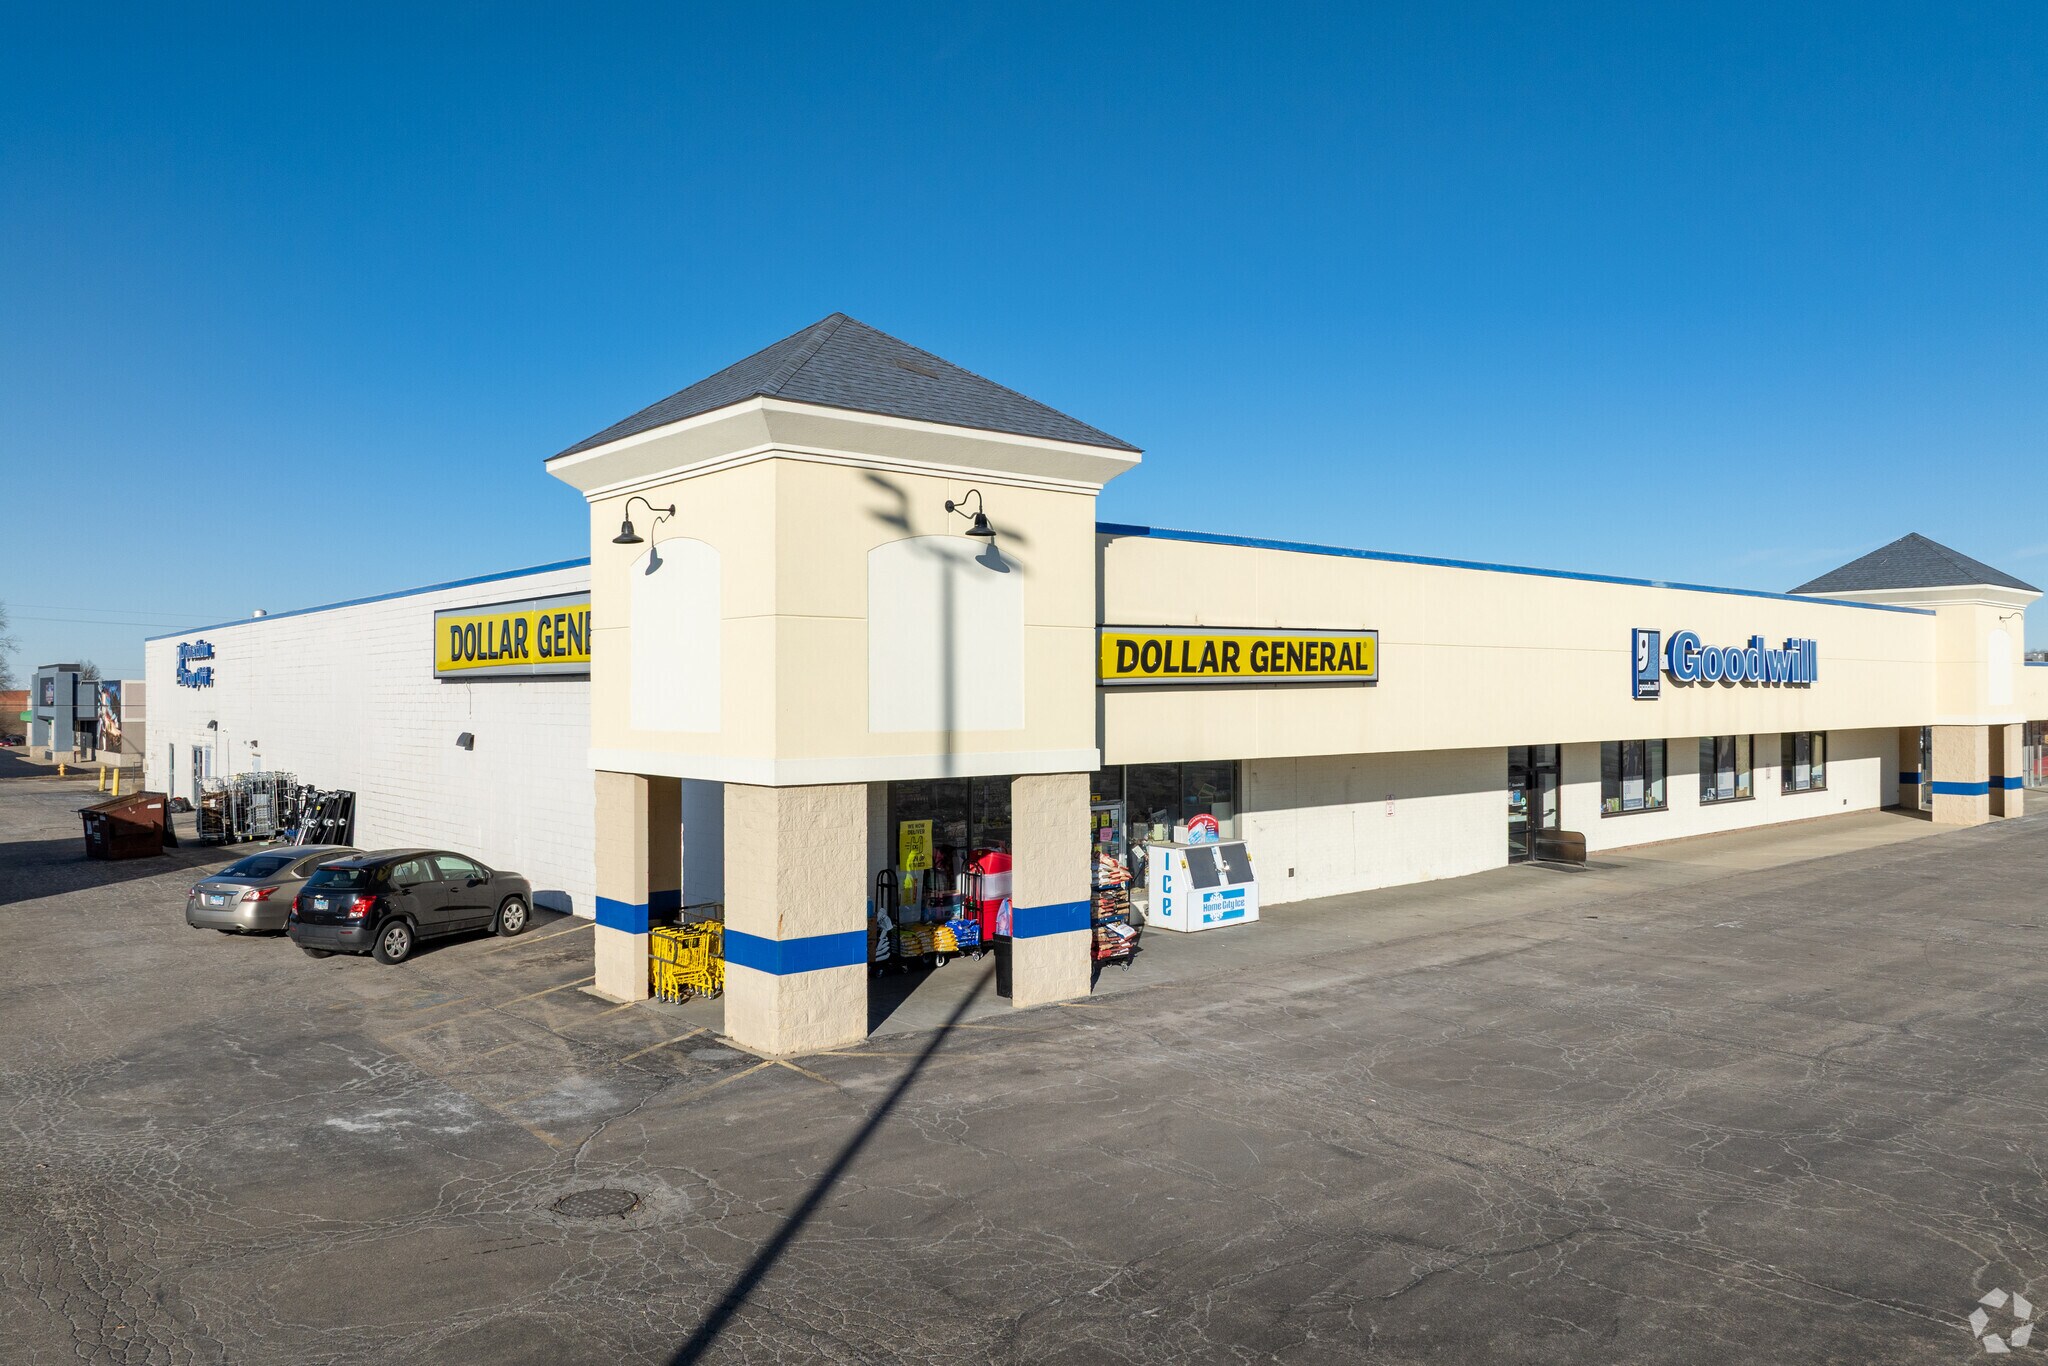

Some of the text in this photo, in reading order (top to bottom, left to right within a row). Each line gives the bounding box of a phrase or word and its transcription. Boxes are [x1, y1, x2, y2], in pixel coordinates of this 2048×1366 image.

[450, 617, 529, 662] DOLLAR
[1116, 639, 1368, 674] DOLLAR GENERAL
[1668, 629, 1818, 683] Goodwill
[1203, 899, 1245, 912] Home City Ice
